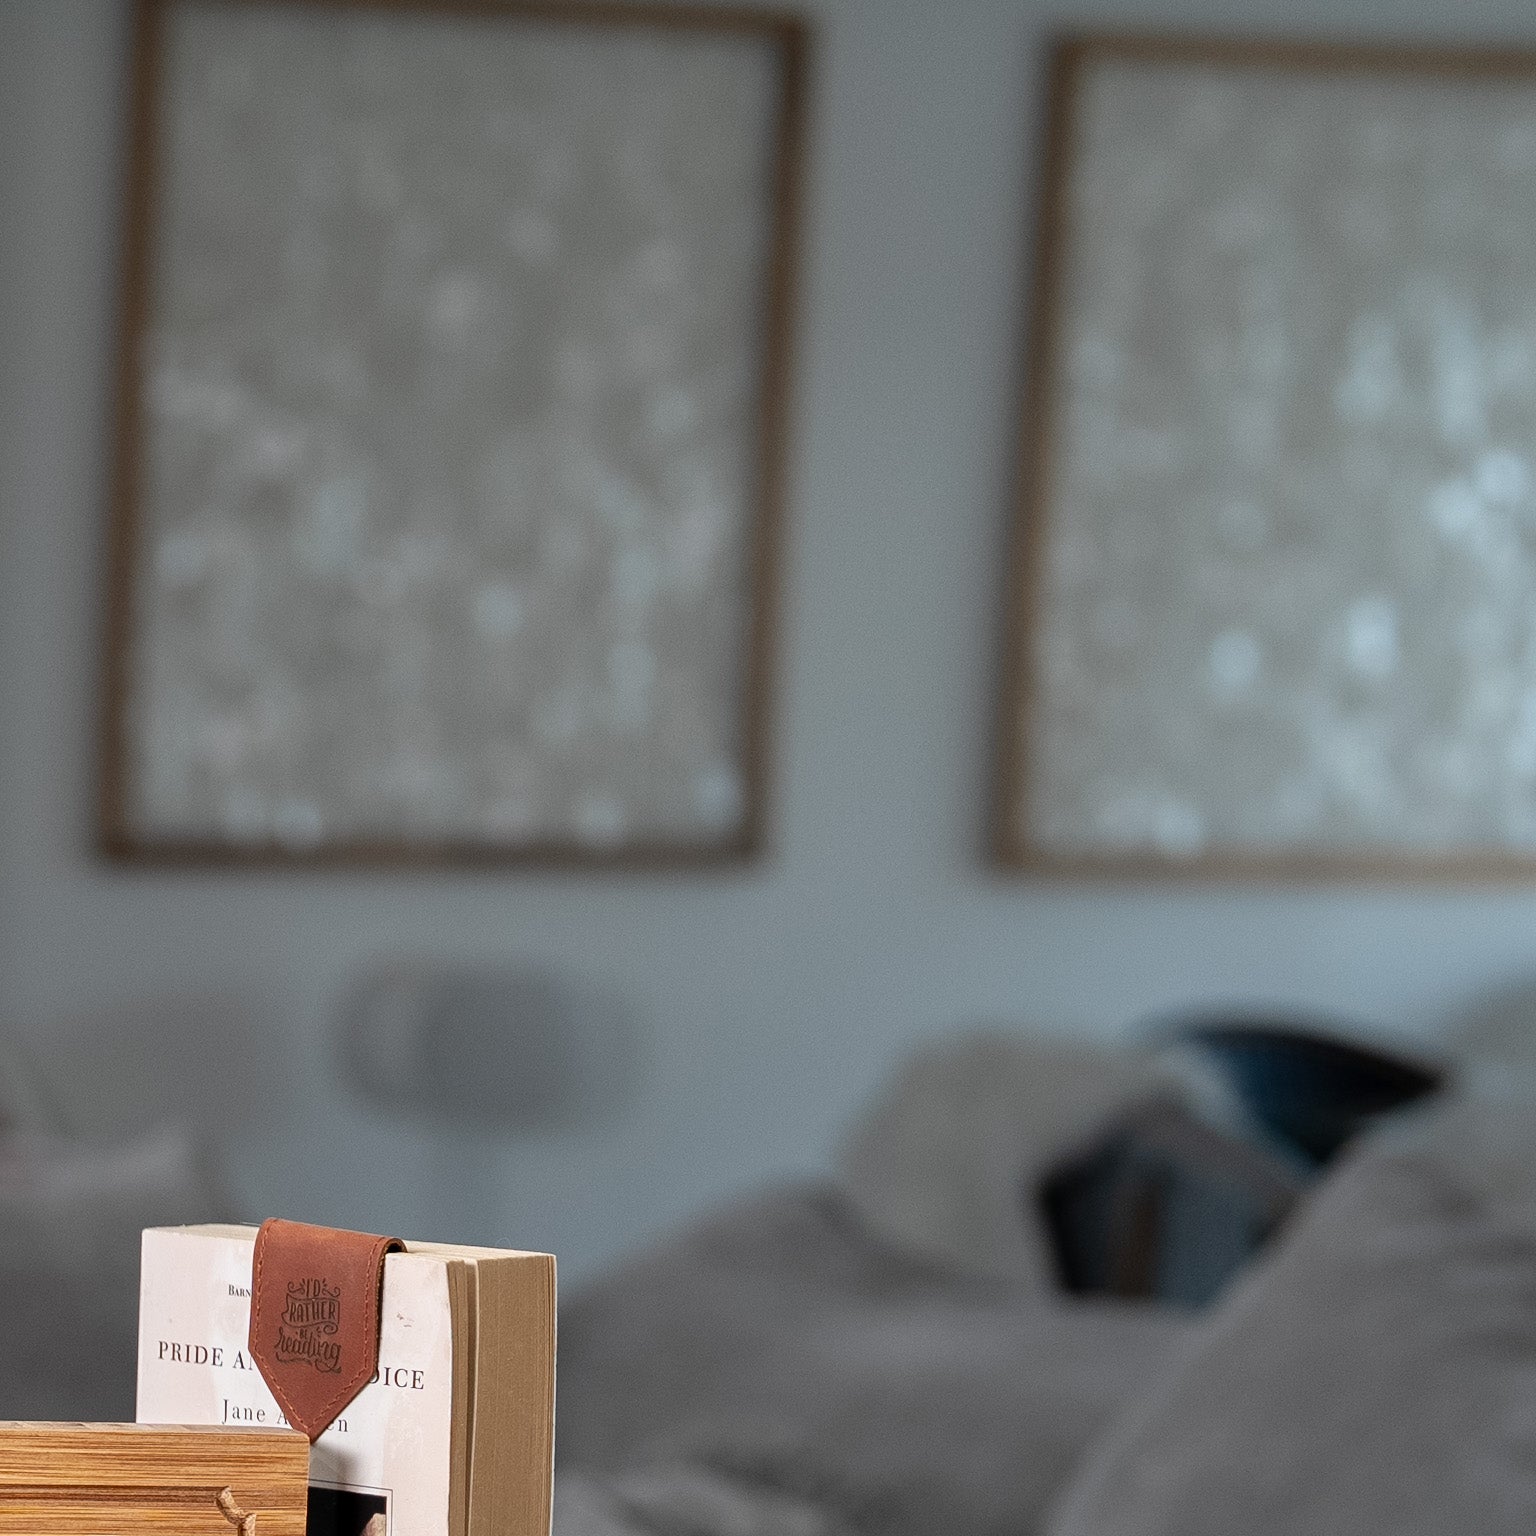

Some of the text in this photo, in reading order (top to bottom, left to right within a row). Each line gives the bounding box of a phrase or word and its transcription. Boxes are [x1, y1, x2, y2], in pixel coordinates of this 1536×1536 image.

[228, 1284, 252, 1298] BARN
[289, 1300, 336, 1322] RATHER
[157, 1340, 225, 1368] PRIDE
[274, 1326, 342, 1373] reading
[221, 1398, 266, 1425] Jane
